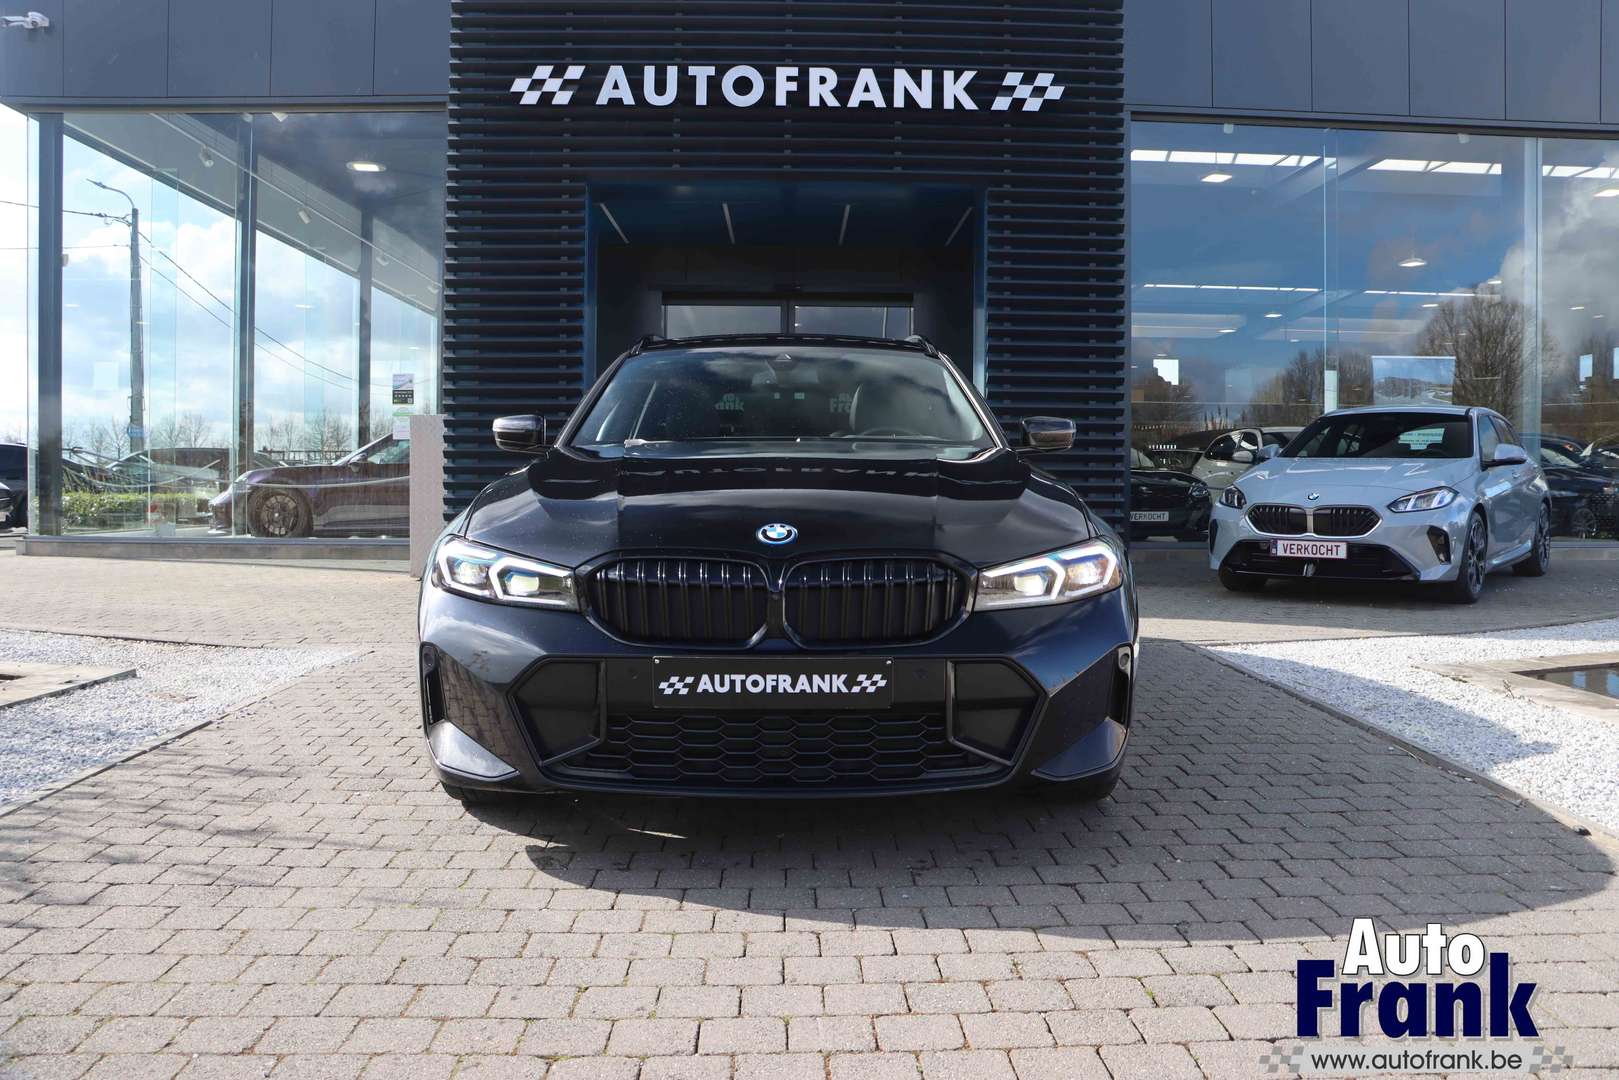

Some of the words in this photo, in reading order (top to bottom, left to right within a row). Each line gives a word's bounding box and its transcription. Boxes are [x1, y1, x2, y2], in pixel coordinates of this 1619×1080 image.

[595, 64, 979, 110] AUTOFRANK
[1282, 543, 1341, 556] VERKOCHT
[697, 673, 849, 694] AUTOFRANK
